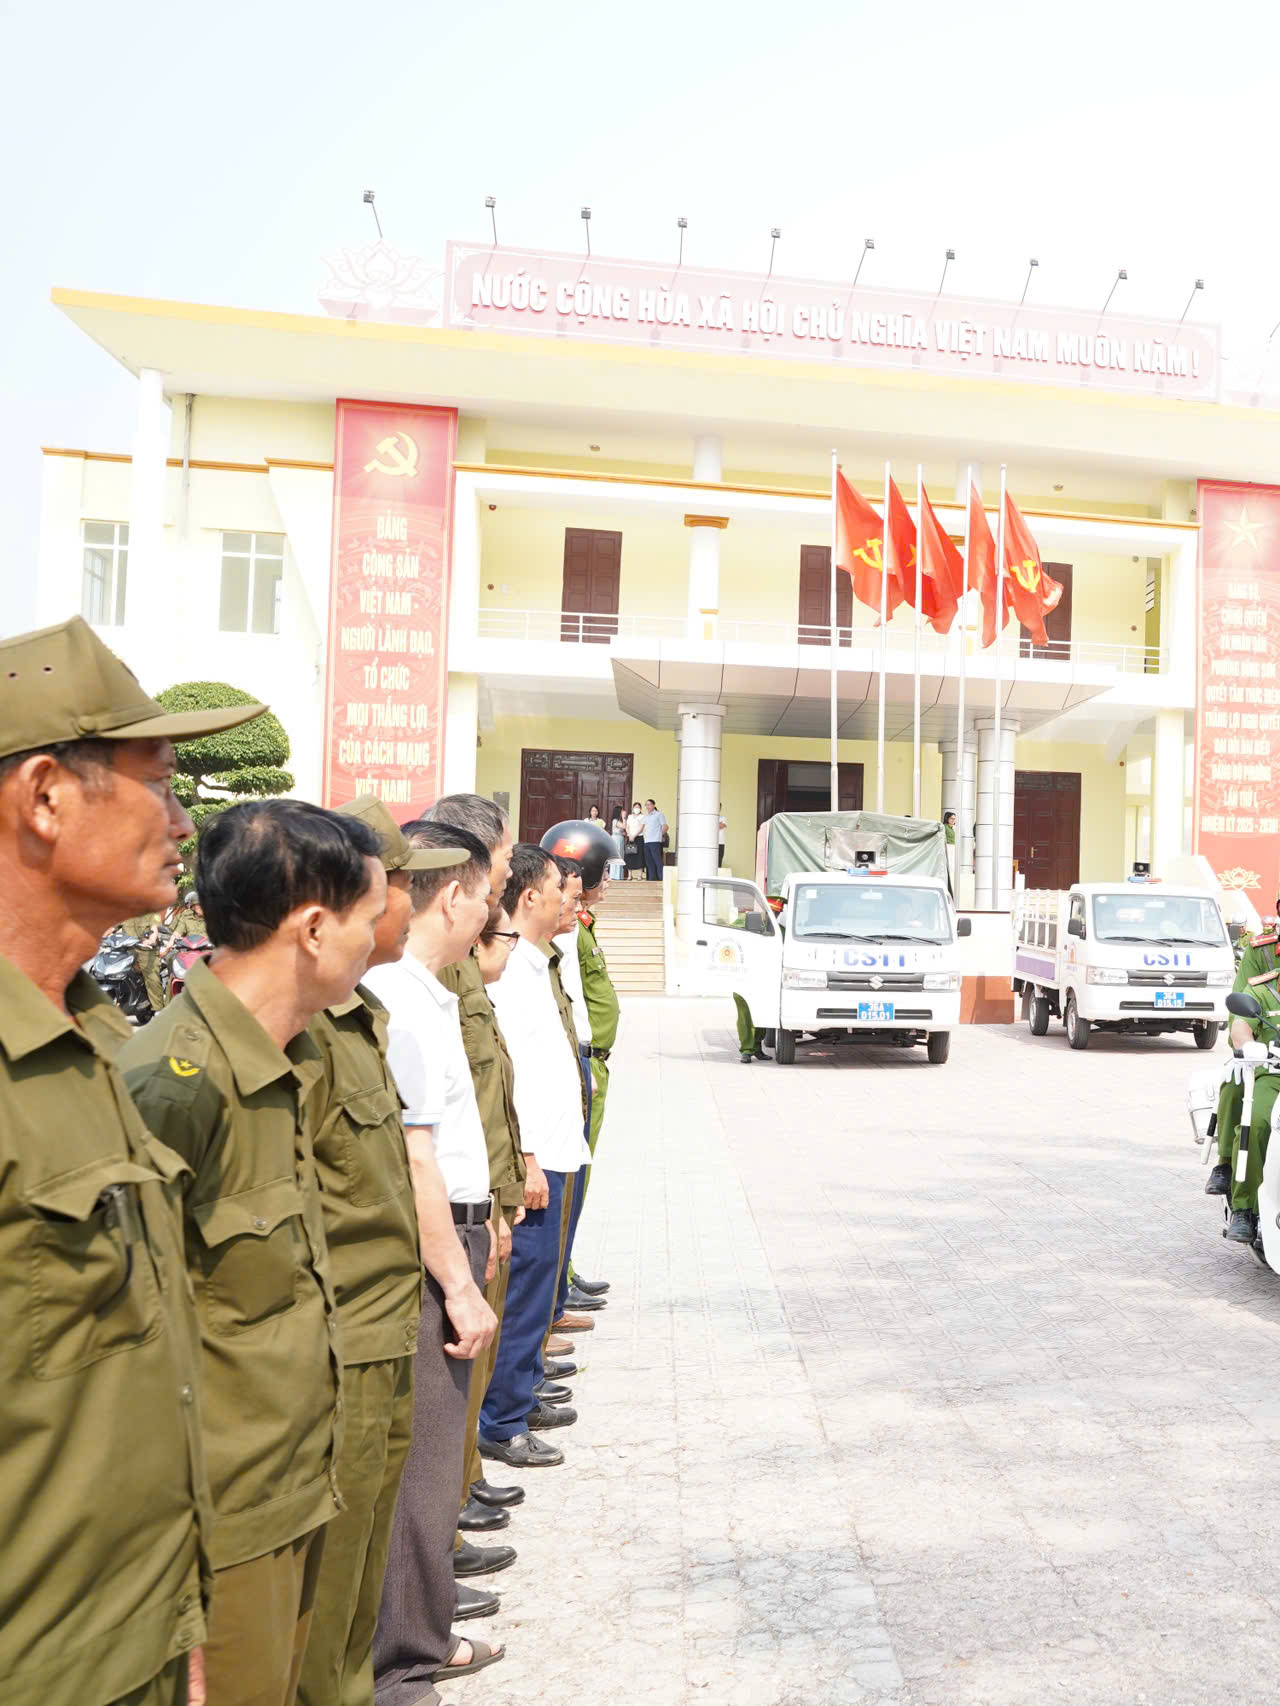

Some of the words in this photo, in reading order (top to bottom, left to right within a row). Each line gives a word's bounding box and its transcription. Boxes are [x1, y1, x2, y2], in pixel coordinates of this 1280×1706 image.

[472, 269, 547, 313] NƯỚC
[555, 279, 630, 325] CỘNG
[637, 283, 691, 327] HÒA
[698, 295, 735, 332] XÃ
[742, 296, 785, 342] HỘI
[791, 298, 845, 342] CHỦ
[850, 313, 929, 352] NGHĨA
[934, 320, 987, 361] VIỆT
[993, 327, 1048, 363] NAM
[1055, 334, 1127, 371] MUÔN
[362, 548, 393, 581] CỘNG
[396, 548, 420, 579] SẢN
[359, 585, 384, 618] VIỆT
[385, 592, 412, 615] NAM
[341, 623, 376, 652] NGƯỜI
[378, 624, 408, 653] LÃNH
[364, 657, 378, 690] TỔ
[380, 662, 409, 690] CHỨC
[346, 702, 369, 734] MỌI
[372, 696, 408, 728] THẮNG
[410, 703, 427, 734] LỢI
[339, 734, 361, 765] CỦA
[364, 736, 394, 765] CÁCH
[396, 742, 430, 771] MẠNG
